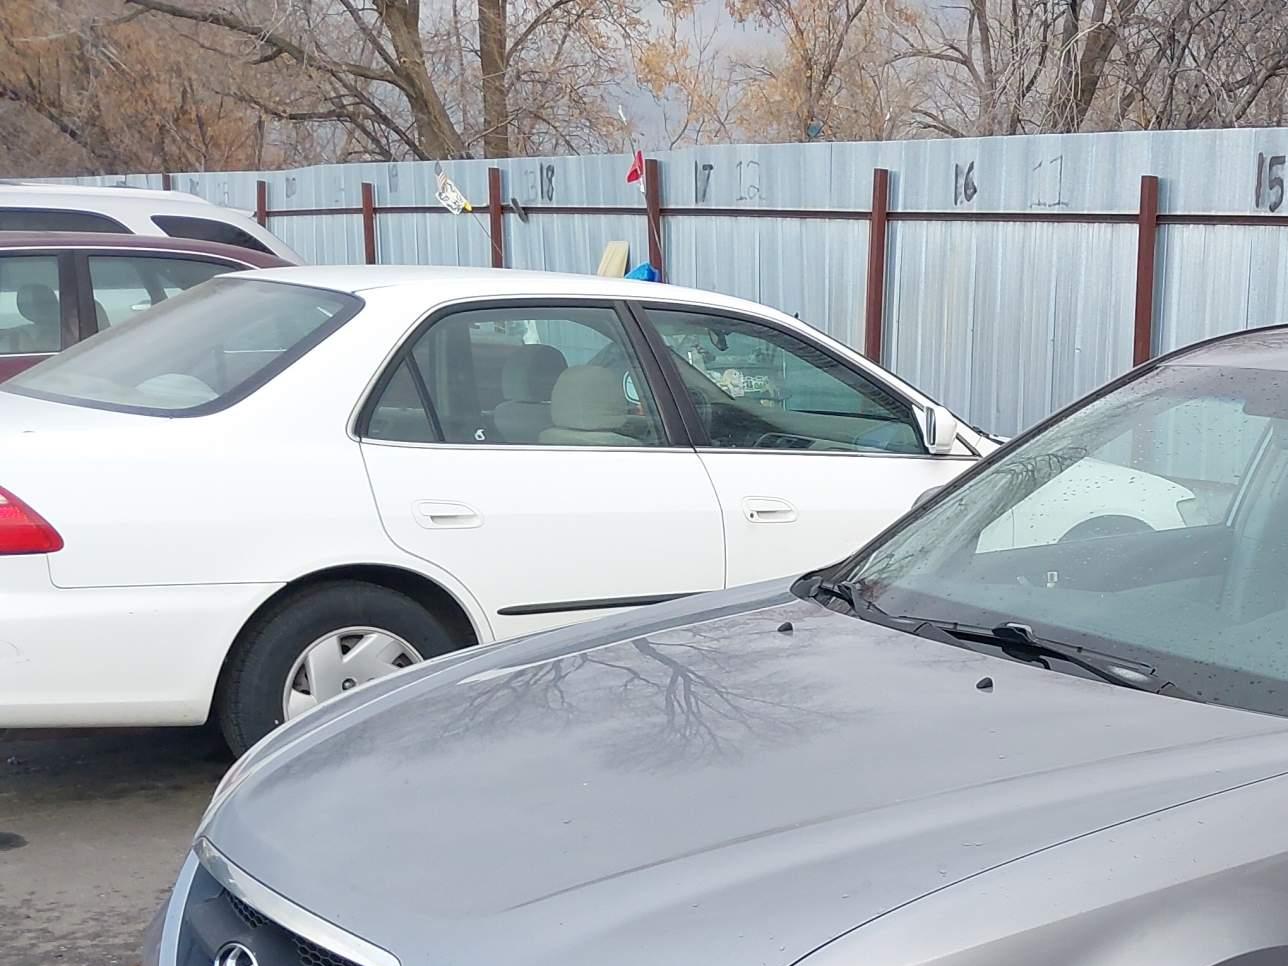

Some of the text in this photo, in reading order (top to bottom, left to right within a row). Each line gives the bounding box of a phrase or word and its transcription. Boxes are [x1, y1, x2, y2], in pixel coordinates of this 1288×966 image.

[539, 161, 555, 202] 18
[694, 160, 714, 204] 17
[953, 160, 978, 206] 16
[1254, 151, 1287, 213] 15
